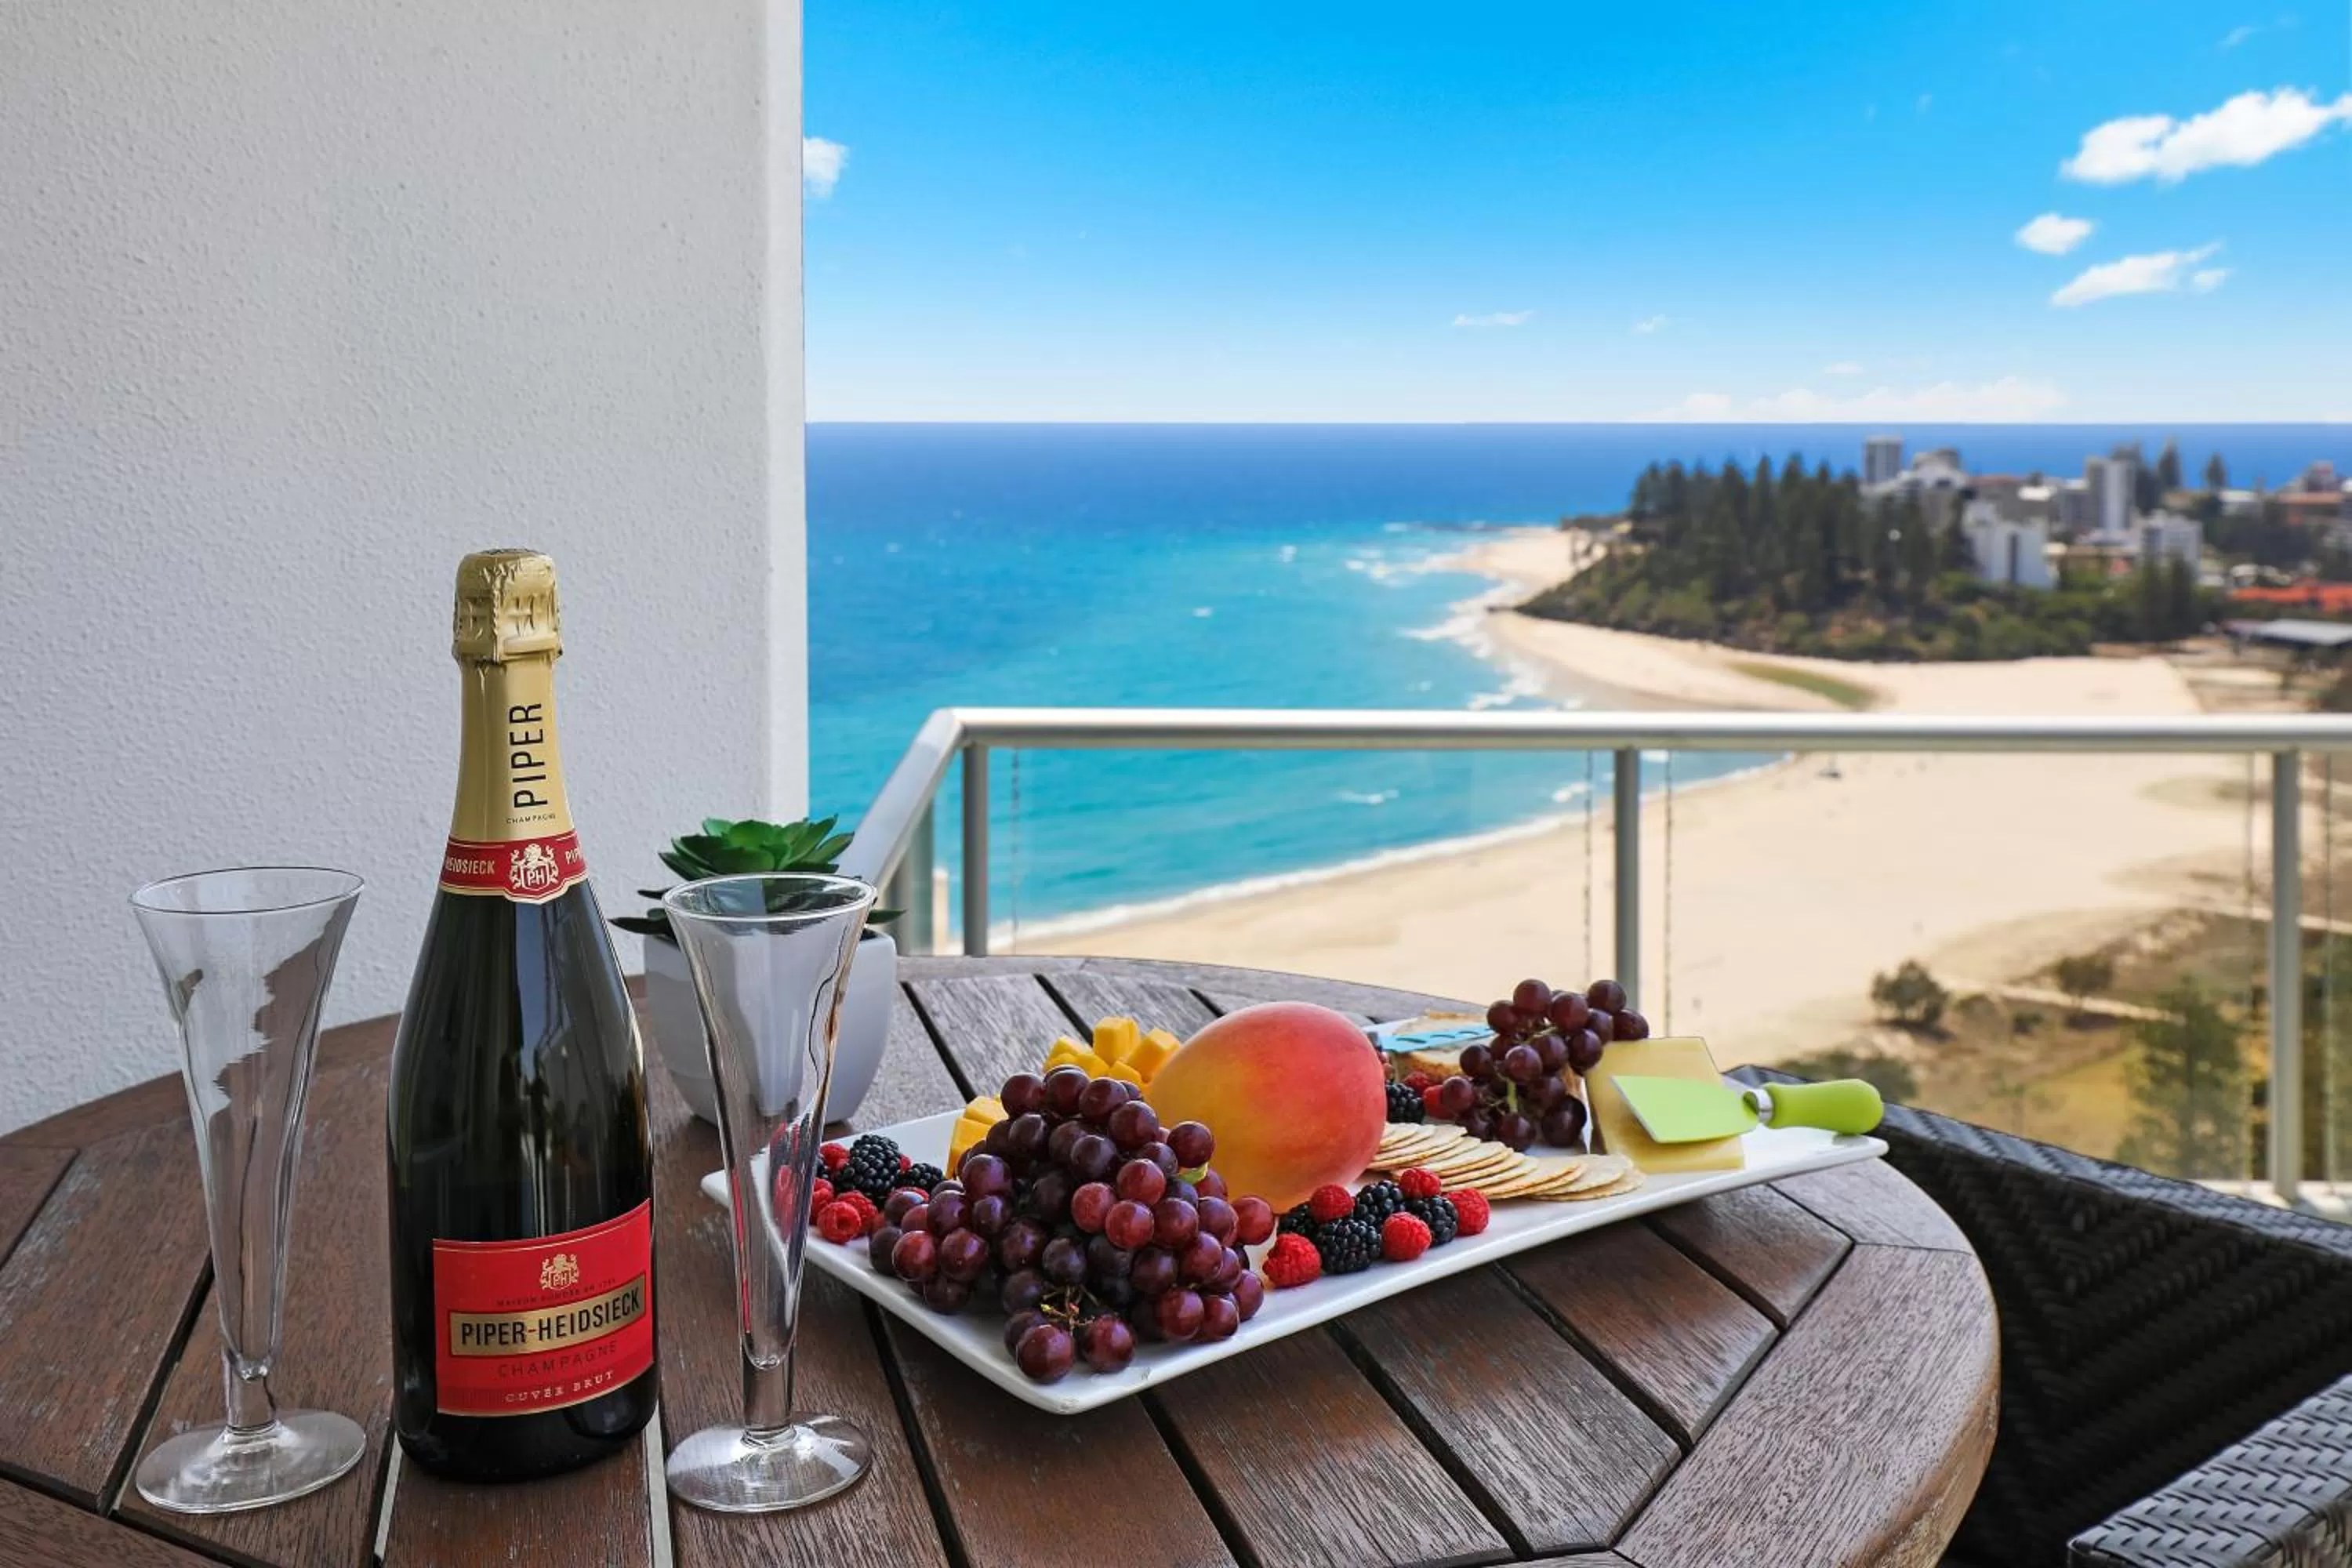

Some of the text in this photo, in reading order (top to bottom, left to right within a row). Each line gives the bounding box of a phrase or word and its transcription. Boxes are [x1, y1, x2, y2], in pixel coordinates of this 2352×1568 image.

[509, 702, 548, 808] PIPER
[506, 813, 556, 825] CHAMPAGNE
[526, 867, 545, 886] PH
[460, 1286, 641, 1346] PIPER-HEIDSIECK
[498, 1340, 618, 1377] CHAMPAGNE
[572, 1370, 615, 1392] BRUT
